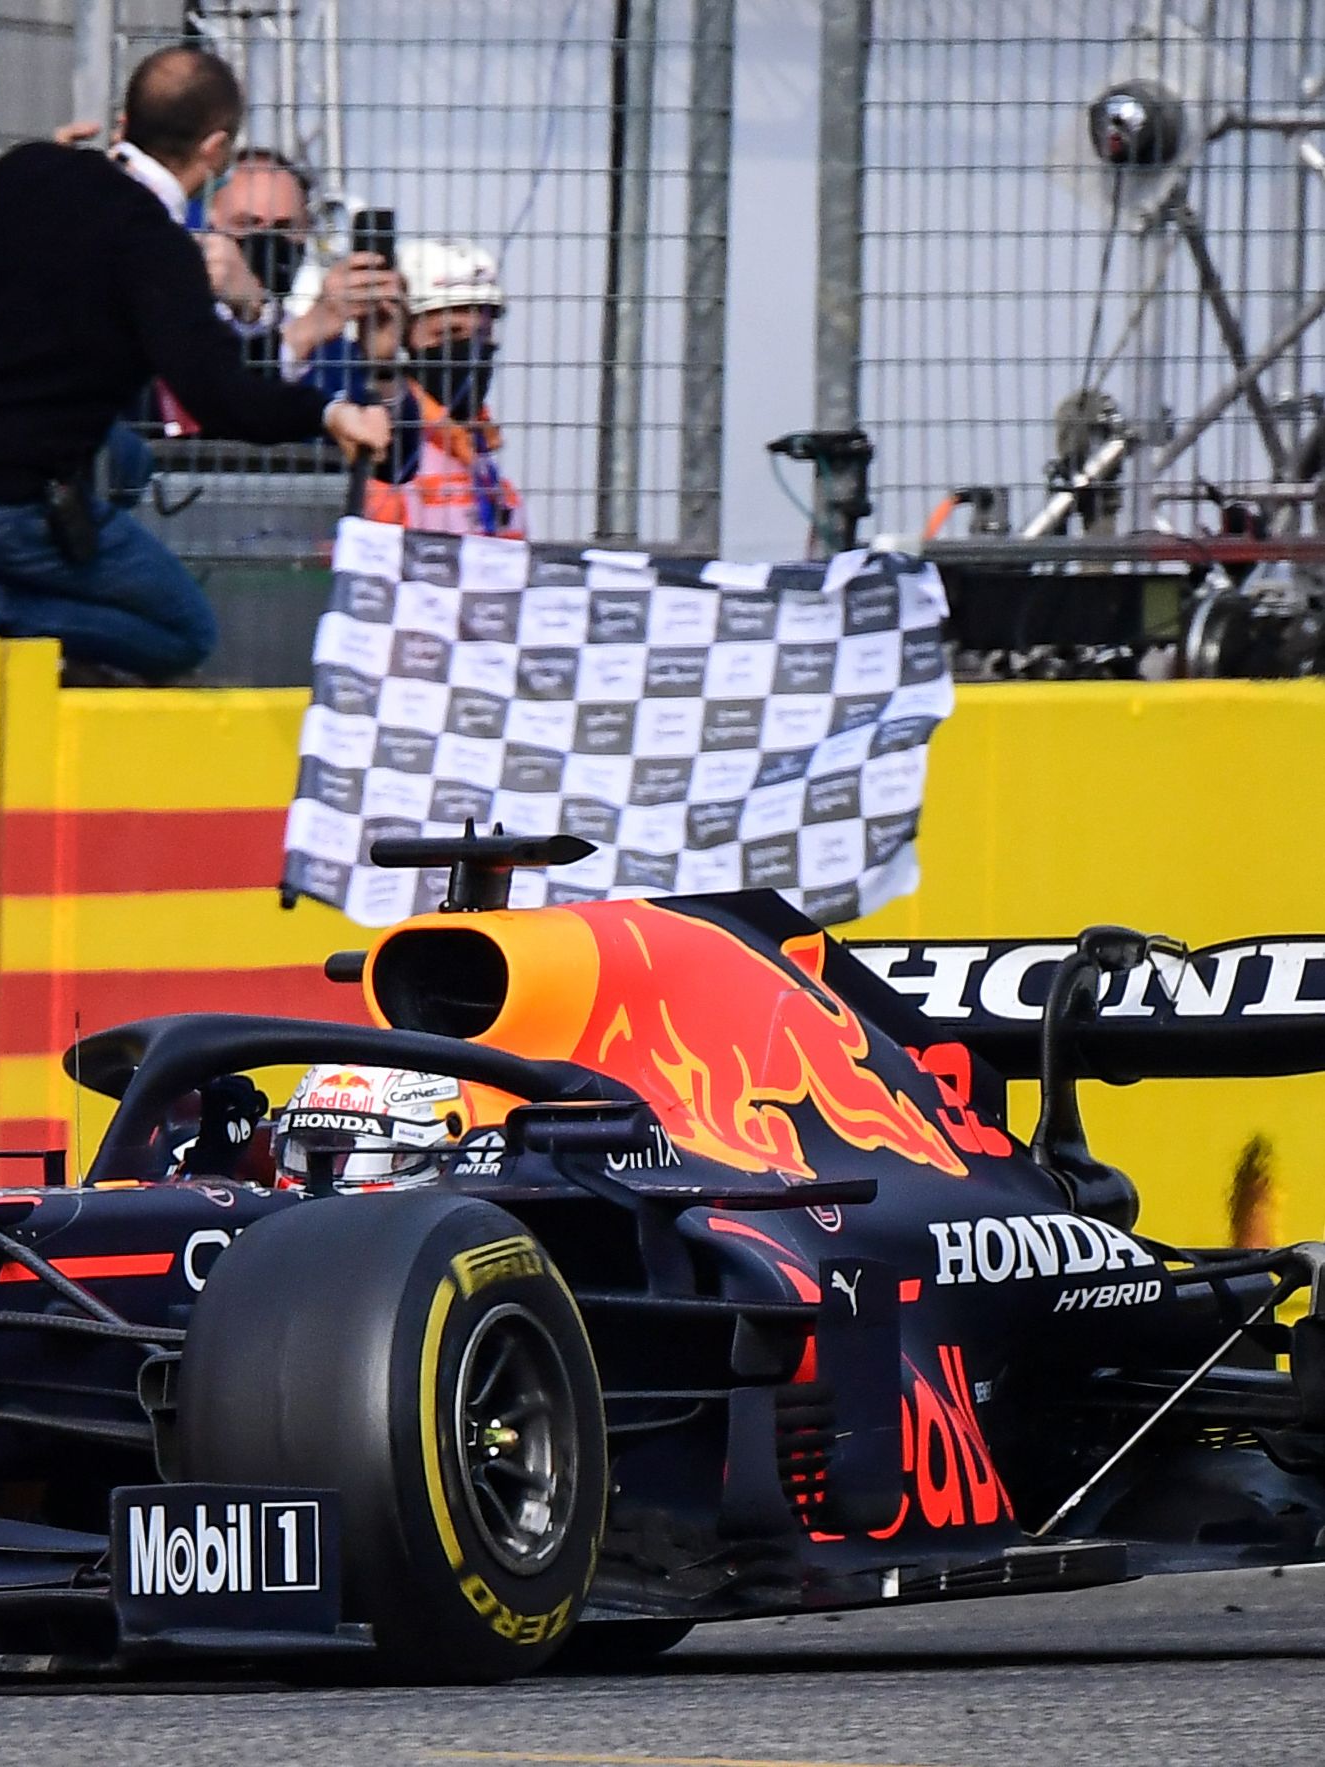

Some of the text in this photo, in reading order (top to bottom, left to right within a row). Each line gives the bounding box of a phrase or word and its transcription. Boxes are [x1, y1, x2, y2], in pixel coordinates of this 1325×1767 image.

[308, 1090, 337, 1109] Red
[339, 1092, 374, 1114] Bull
[291, 1113, 384, 1135] HONDA
[454, 1162, 502, 1177] INTER
[928, 1214, 1156, 1285] HONDA
[1053, 1280, 1162, 1313] HYBRID
[129, 1503, 253, 1596] Mobil
